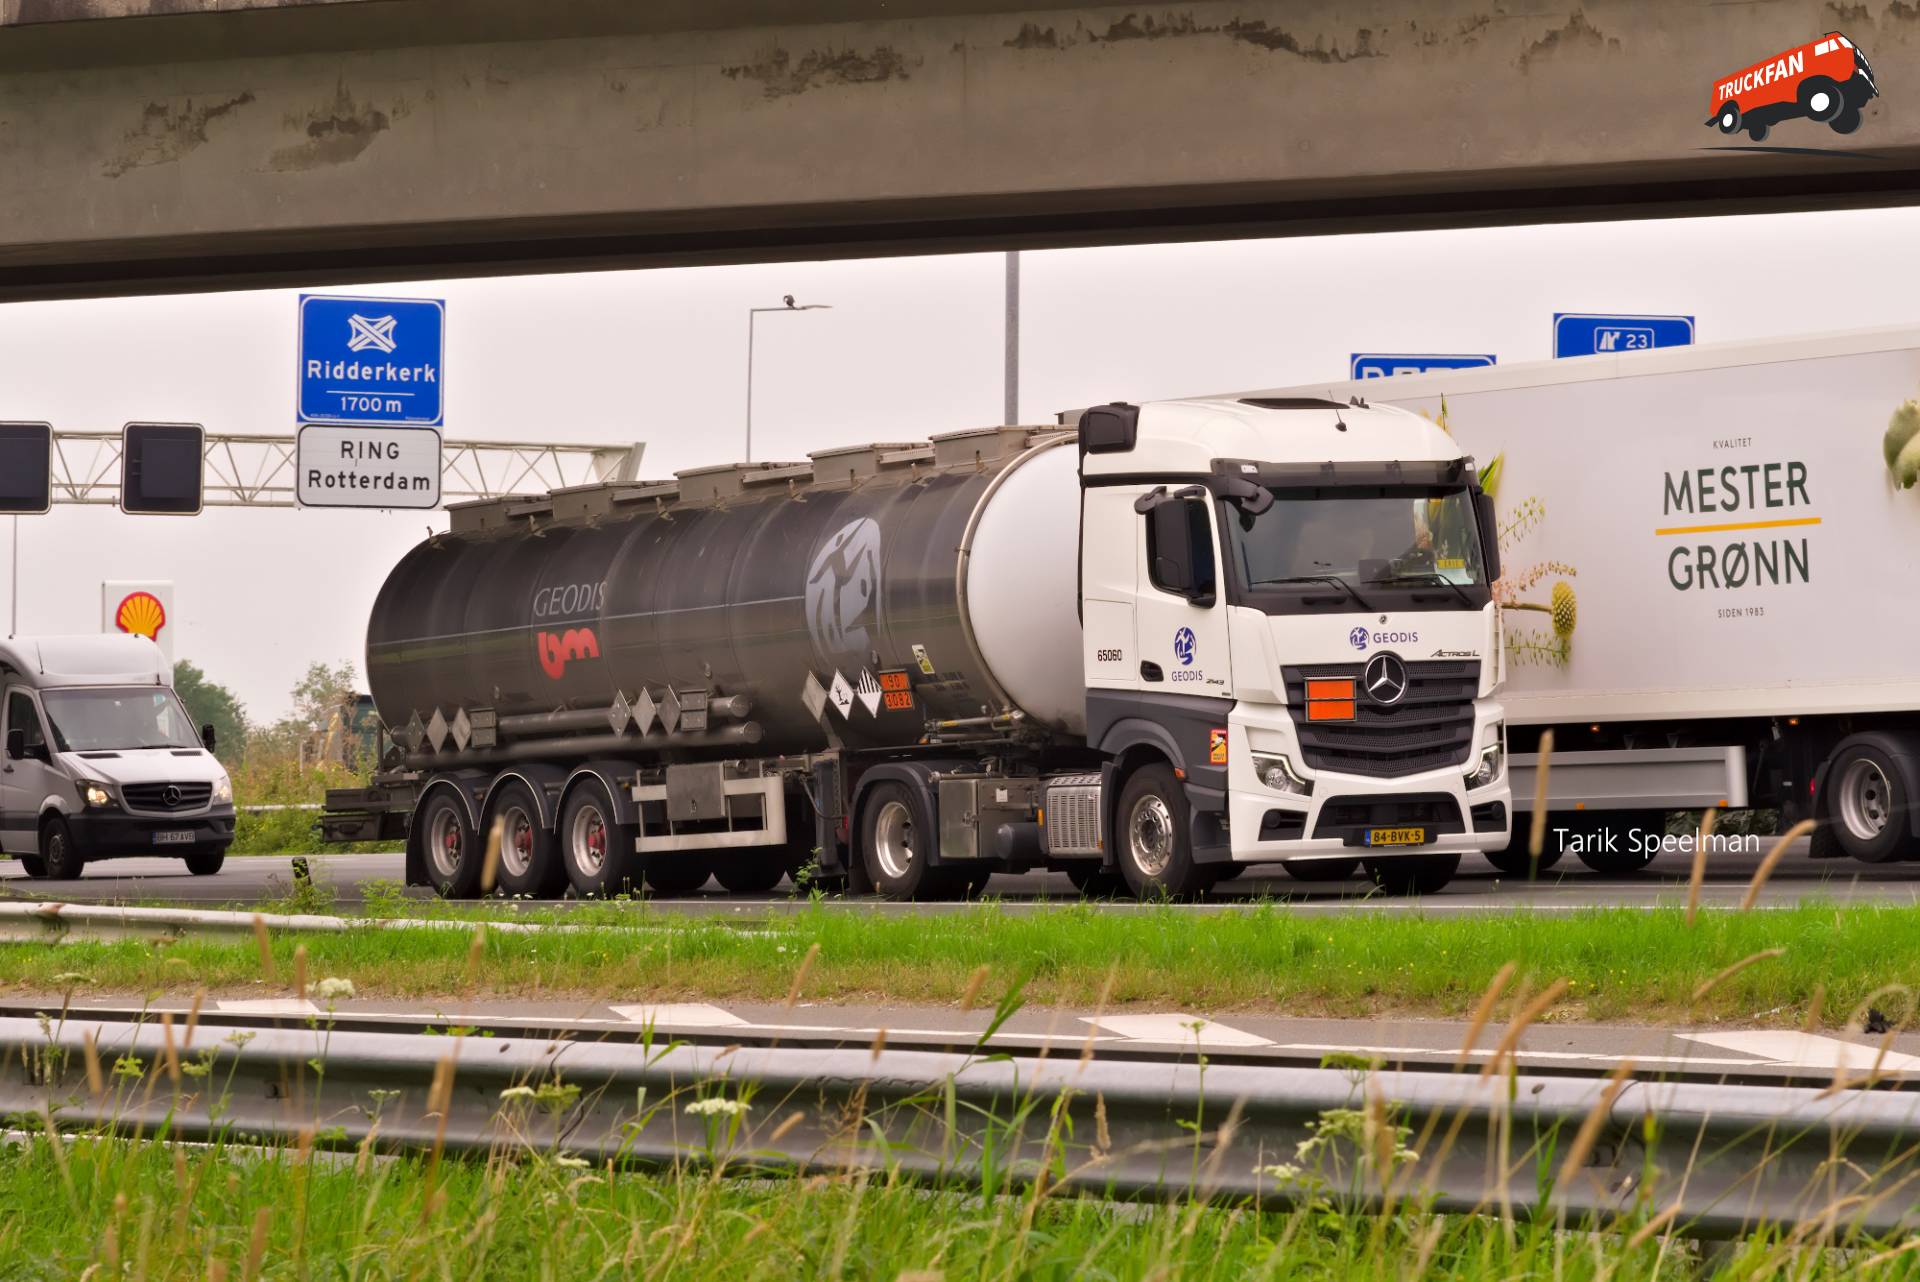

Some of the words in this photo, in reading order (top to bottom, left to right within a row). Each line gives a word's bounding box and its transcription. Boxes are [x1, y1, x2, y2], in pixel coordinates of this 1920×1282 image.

[1625, 334, 1648, 349] 23
[307, 359, 436, 382] Ridderkerk
[340, 397, 382, 412] 1700
[385, 399, 402, 412] m
[340, 440, 400, 459] RING
[1712, 437, 1752, 449] KVALITET
[308, 469, 430, 490] Rotterdam
[1663, 461, 1811, 515] MESTER
[1667, 538, 1810, 591] GRØNN
[533, 580, 607, 617] GEODIS
[1717, 608, 1742, 619] SIDEN
[1745, 606, 1765, 617] 1983
[1373, 631, 1419, 644] GEODIS
[887, 674, 900, 689] 90
[1171, 670, 1203, 682] GEODIS
